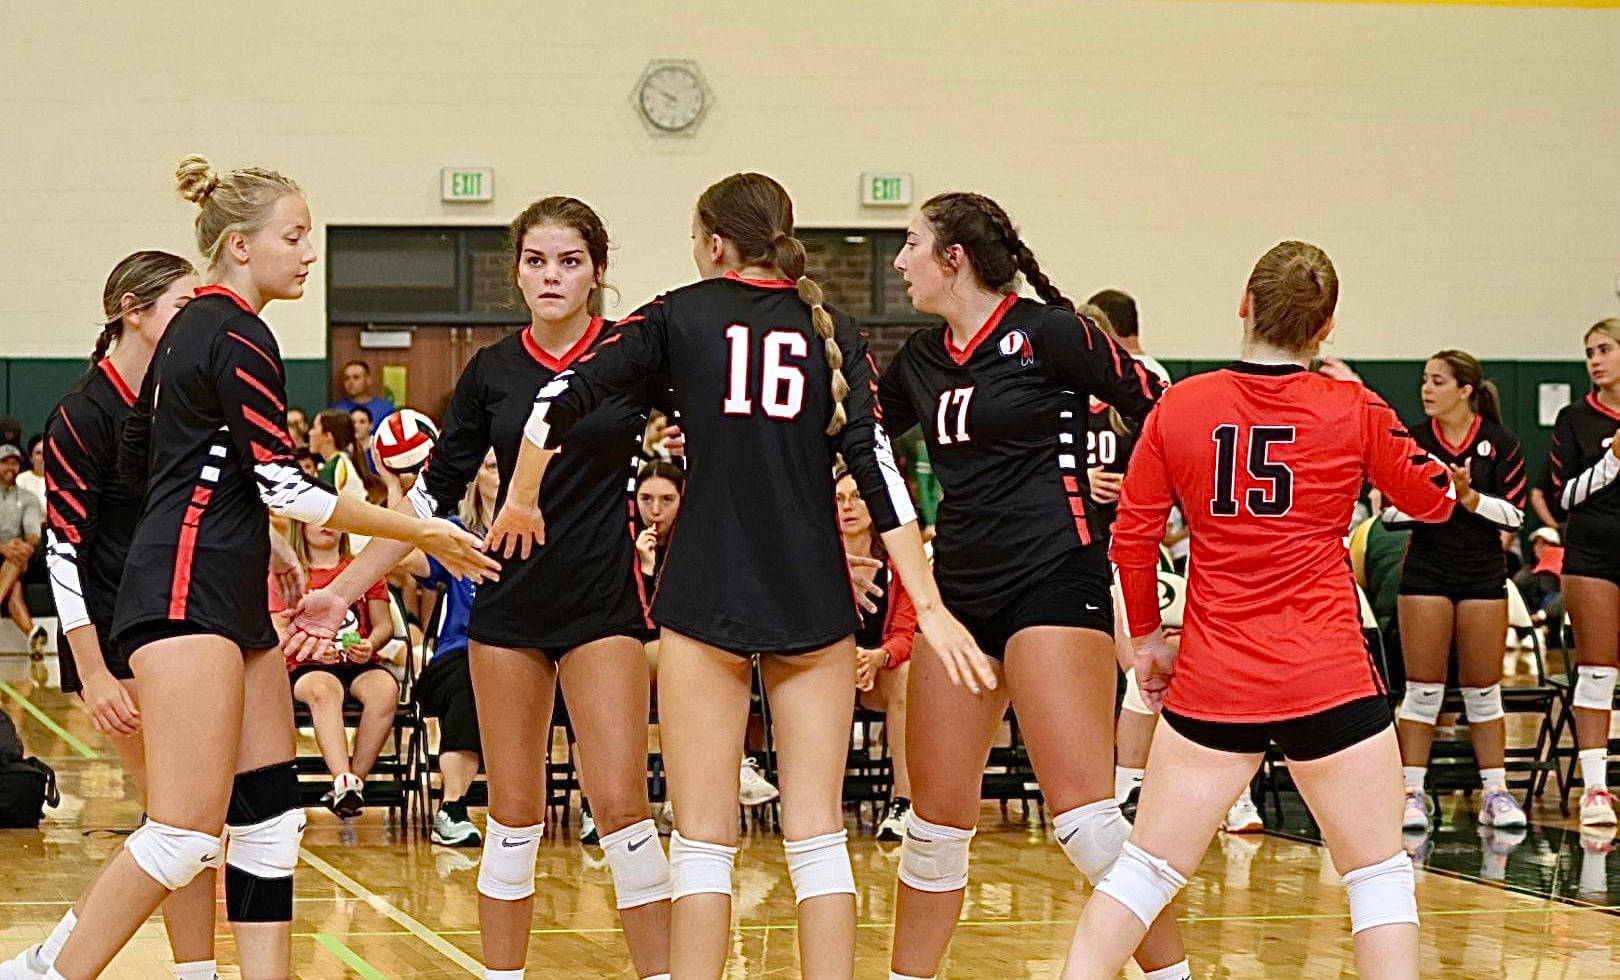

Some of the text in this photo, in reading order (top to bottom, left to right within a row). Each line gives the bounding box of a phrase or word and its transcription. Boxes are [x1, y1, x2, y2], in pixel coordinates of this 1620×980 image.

[452, 172, 482, 196] EXIT
[872, 177, 901, 200] EXIT
[723, 323, 809, 420] 16
[937, 386, 976, 445] 17
[1210, 424, 1296, 517] 15
